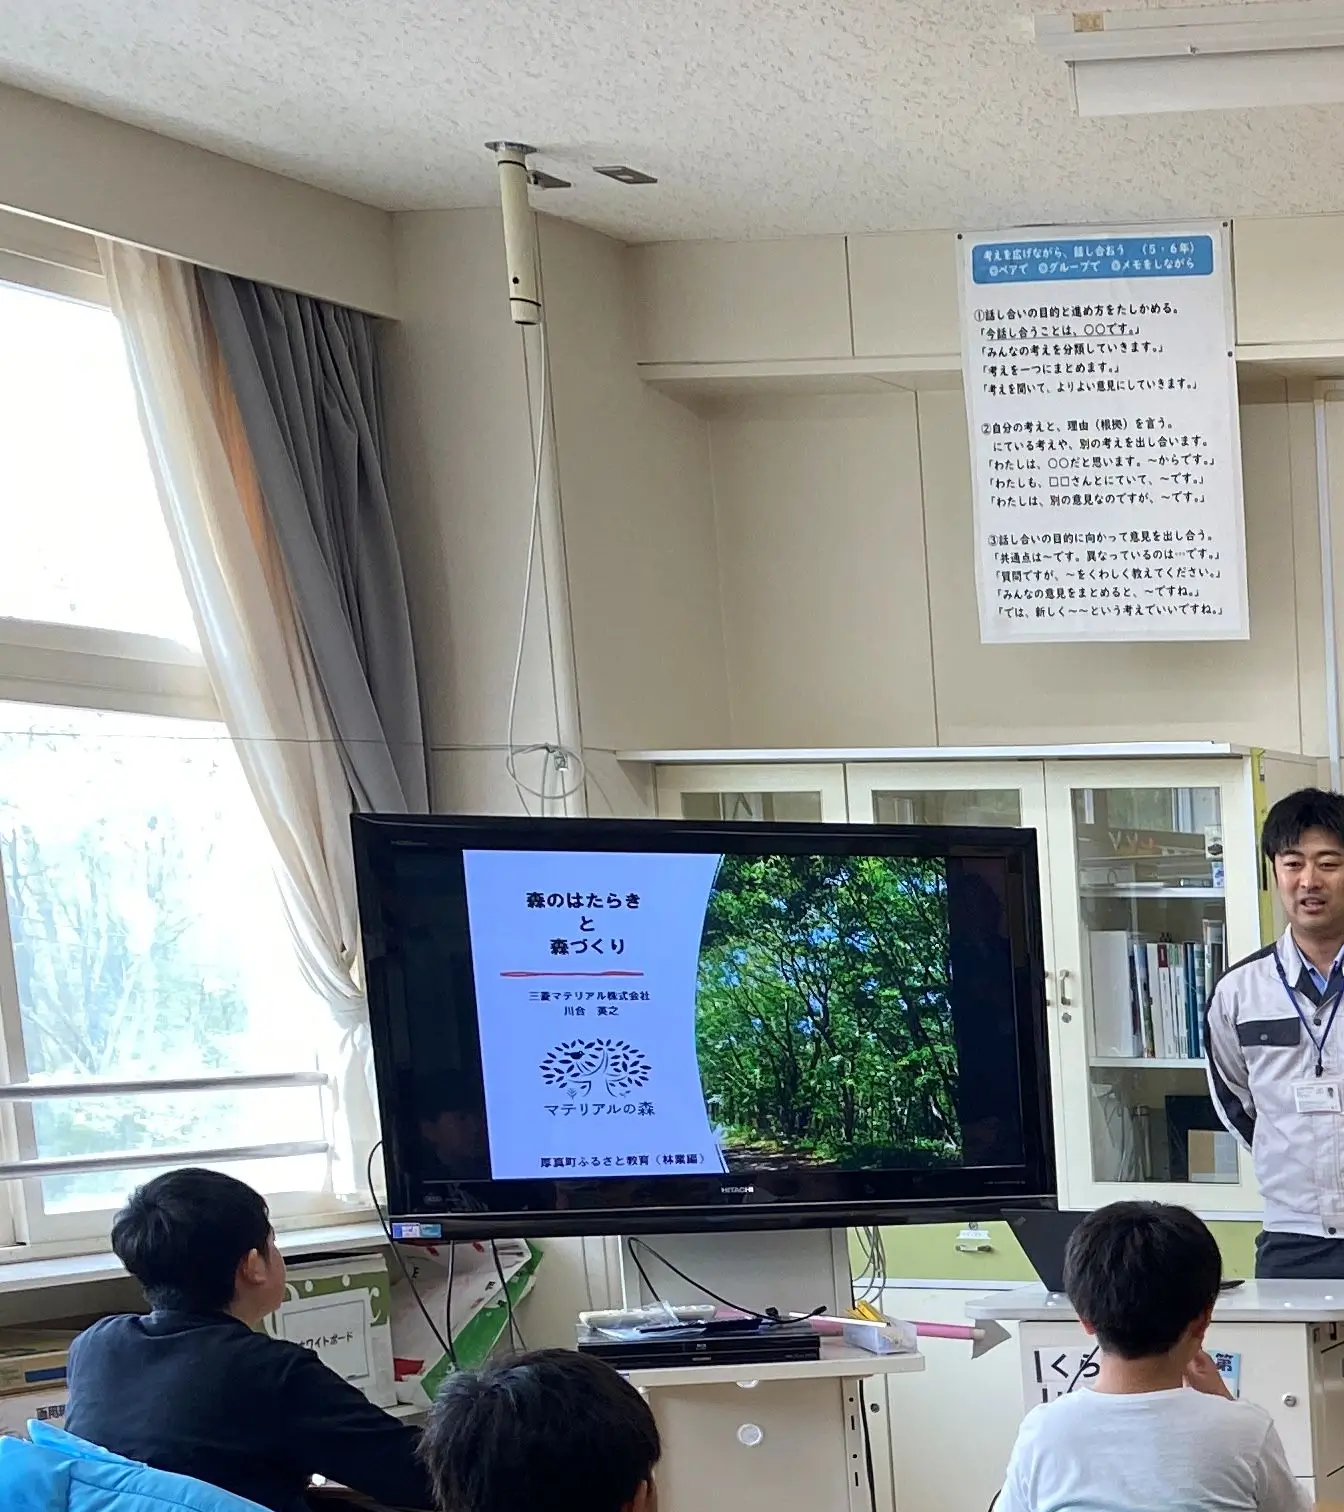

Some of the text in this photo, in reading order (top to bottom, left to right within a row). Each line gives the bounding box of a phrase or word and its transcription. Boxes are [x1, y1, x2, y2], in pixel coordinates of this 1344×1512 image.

[526, 889, 642, 911] 森のはたらき
[578, 916, 595, 933] と
[549, 937, 626, 957] 森づくり
[544, 1101, 656, 1116] マテリアルの森
[720, 1186, 755, 1194] HITACHI
